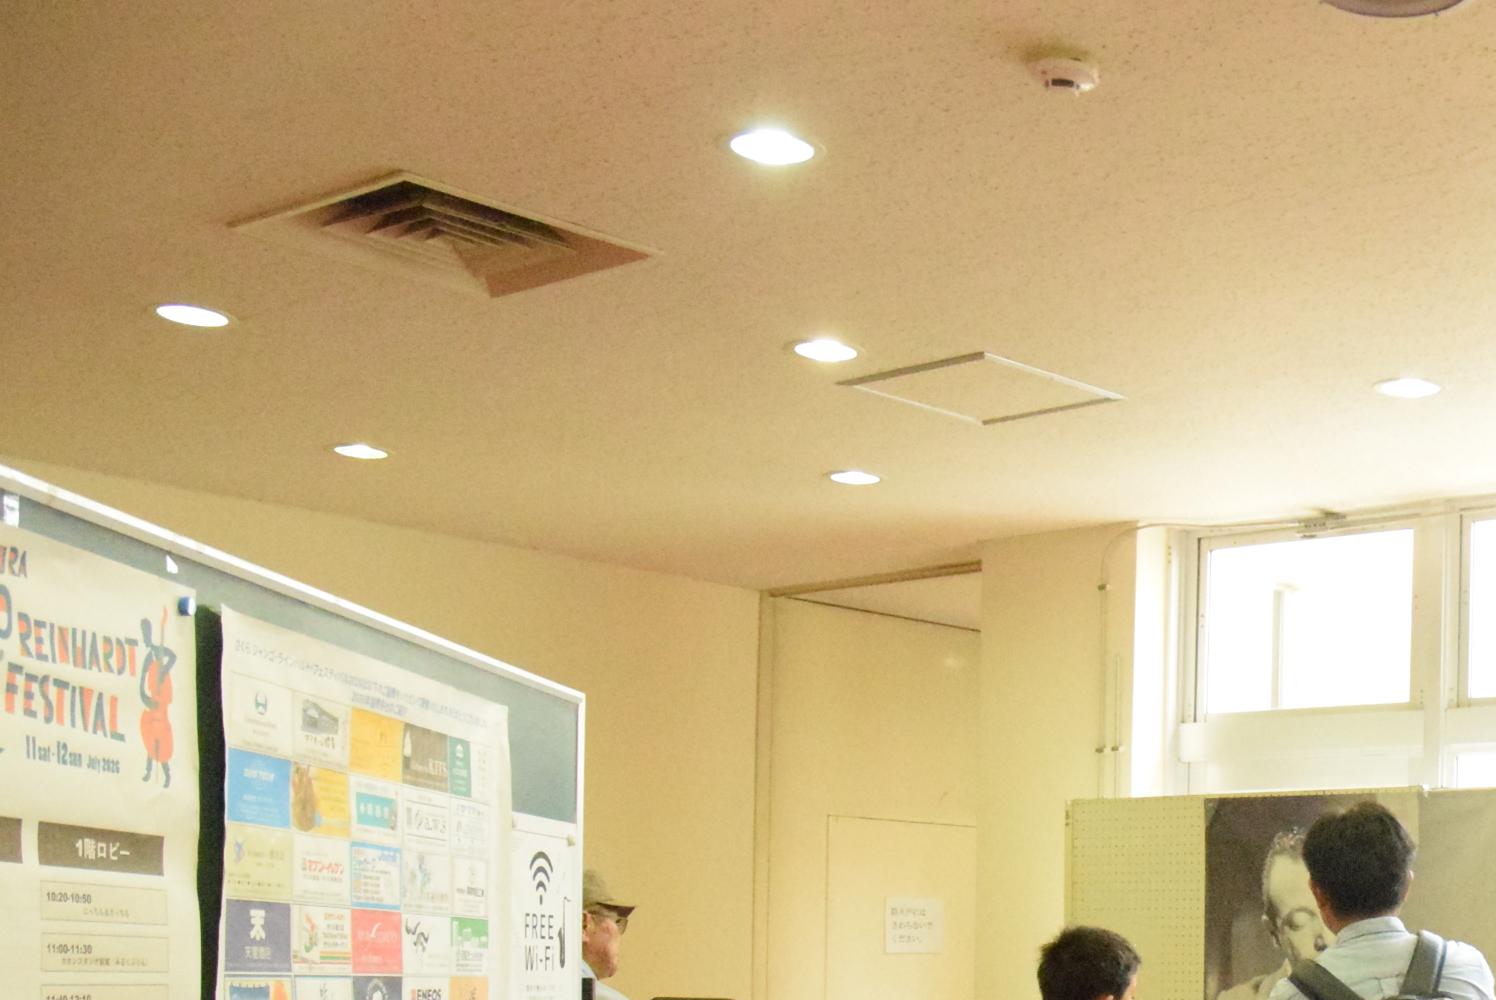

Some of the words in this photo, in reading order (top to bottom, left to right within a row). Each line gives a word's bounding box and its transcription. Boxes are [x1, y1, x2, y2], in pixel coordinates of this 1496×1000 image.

[17, 611, 138, 677] REINHARDT
[5, 662, 125, 743] FESTIVAL
[76, 838, 130, 861] 1階ロビー
[46, 891, 92, 904] 10:20-10:50
[524, 912, 554, 940] FREE
[47, 944, 93, 955] 11:00-11:30
[524, 945, 554, 971] Wi-Fi
